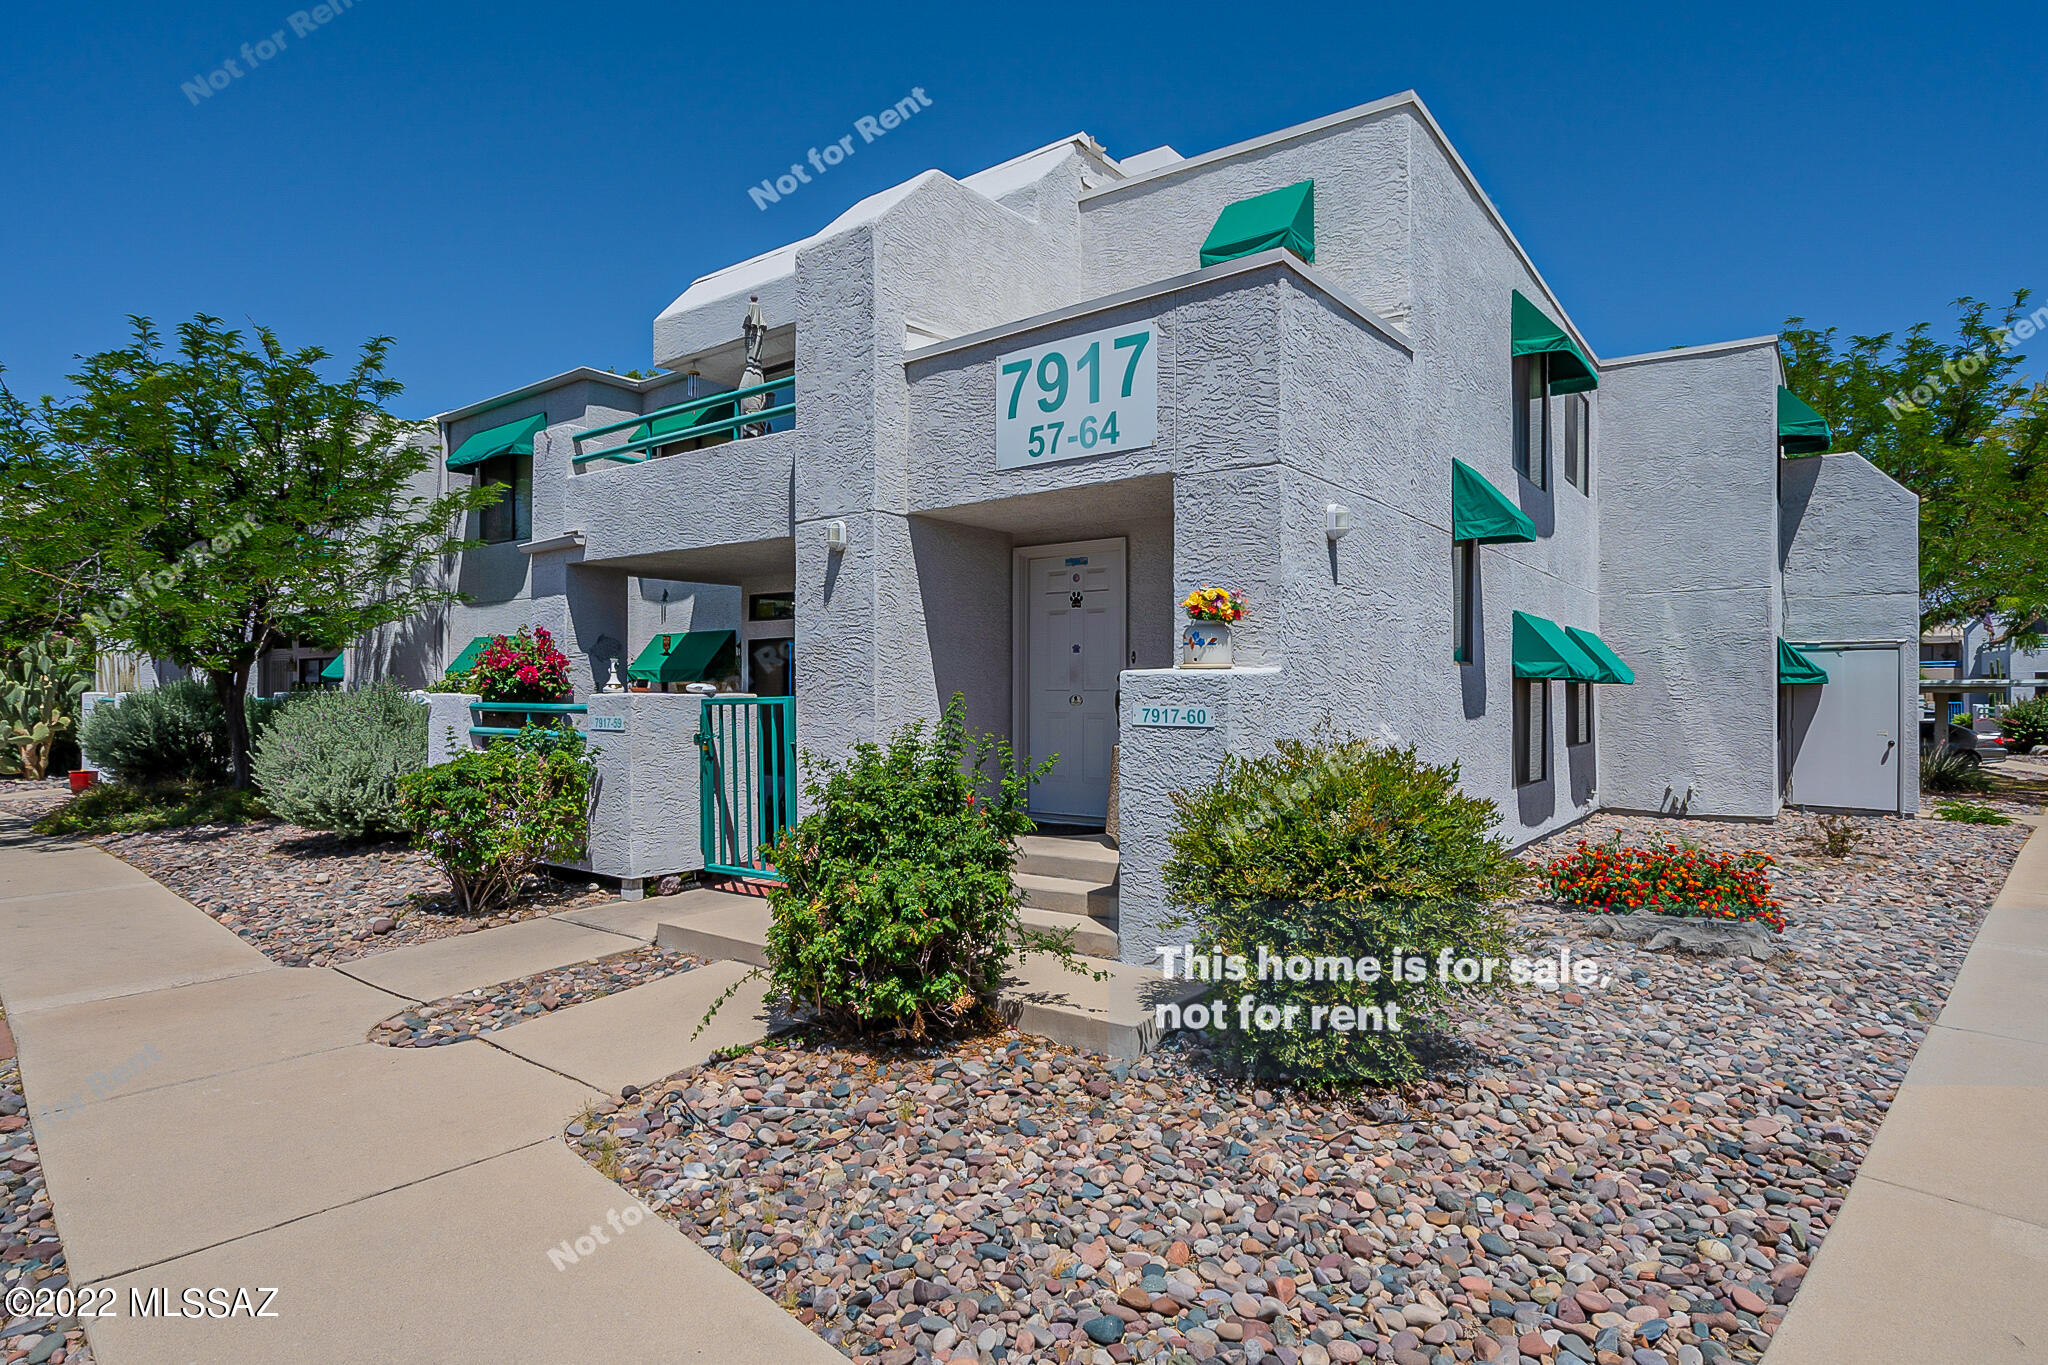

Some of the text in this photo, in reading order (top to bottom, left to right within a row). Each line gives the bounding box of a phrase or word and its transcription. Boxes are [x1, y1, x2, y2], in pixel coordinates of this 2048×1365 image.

[1002, 331, 1150, 420] 7917
[1028, 410, 1120, 458] 57-64
[594, 717, 622, 728] 7917-59
[1142, 707, 1206, 724] 7917-60
